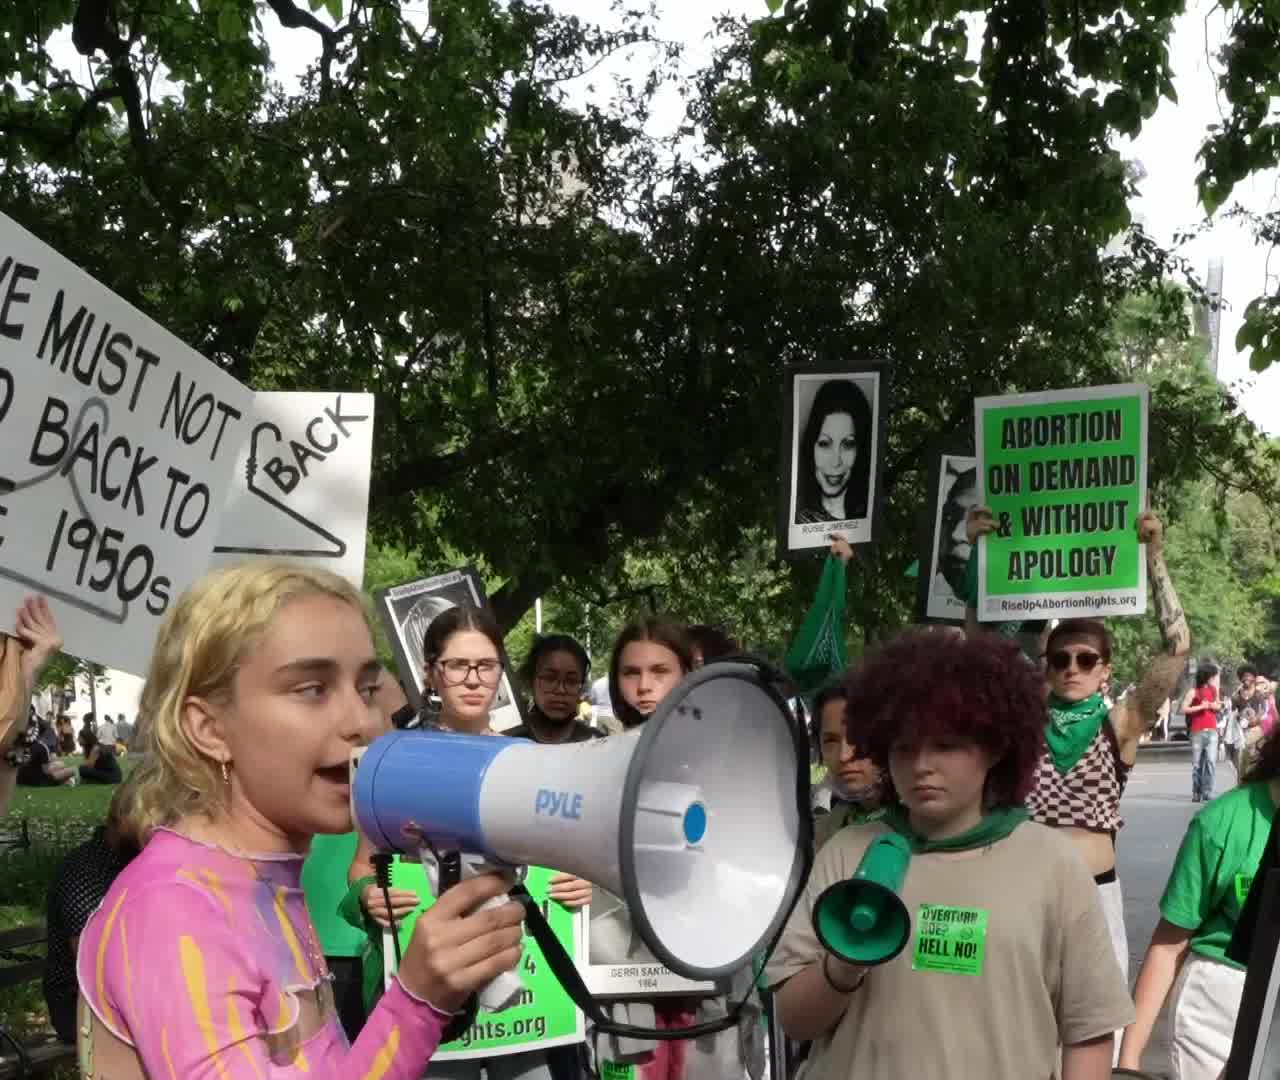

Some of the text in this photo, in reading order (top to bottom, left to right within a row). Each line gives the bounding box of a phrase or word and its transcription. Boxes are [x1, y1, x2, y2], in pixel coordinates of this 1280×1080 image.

[36, 289, 161, 412] MUST
[160, 371, 242, 460] NOT
[263, 394, 369, 495] BACK
[1001, 409, 1121, 449] ABORTION
[29, 396, 158, 516] BACK
[159, 466, 210, 539] TO
[988, 454, 1135, 495] ON DEMAND
[997, 500, 1129, 538] & WITHOUT
[45, 509, 171, 617] 1950s
[1007, 546, 1117, 581] APOLOGY
[1001, 595, 1137, 612] RiseUp4AbortionRights.org
[535, 788, 582, 820] PYLE
[919, 938, 977, 960] HELL NO!
[610, 967, 639, 979] GERRI
[460, 1016, 545, 1047] ghts.org
